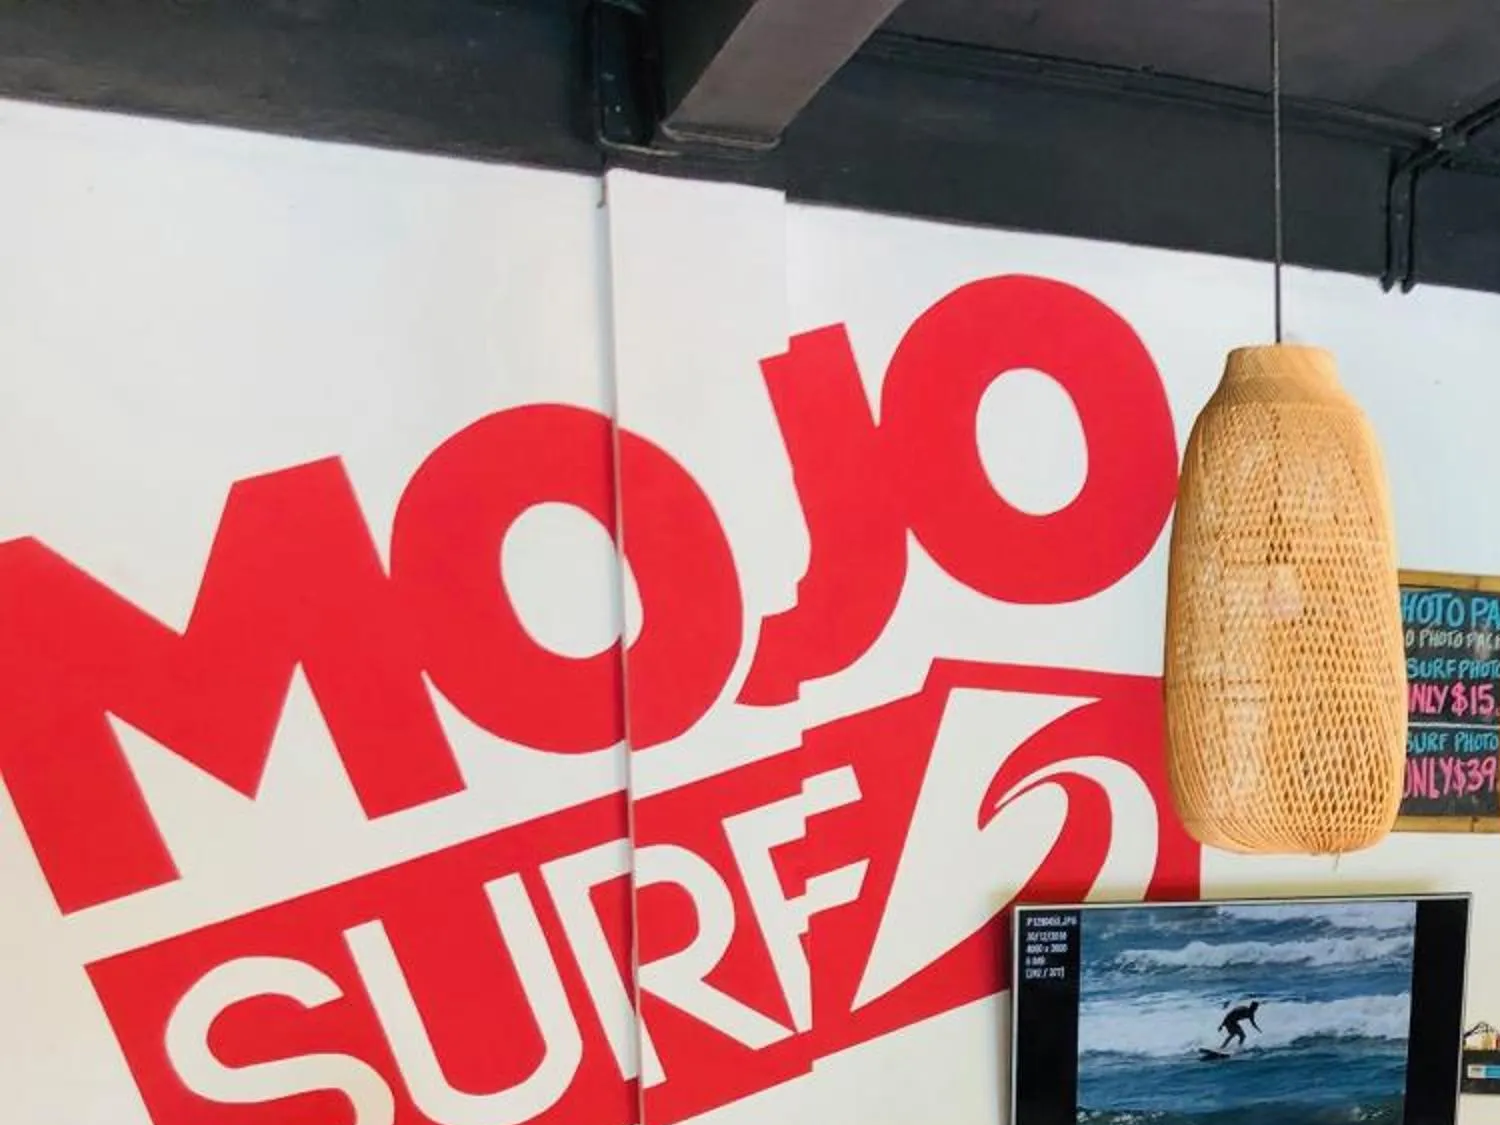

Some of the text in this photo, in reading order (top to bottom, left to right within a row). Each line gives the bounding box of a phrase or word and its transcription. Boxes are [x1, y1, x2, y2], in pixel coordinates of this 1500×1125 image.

[0, 274, 1178, 917] MOJO
[1402, 592, 1465, 628] HOTO
[1419, 629, 1464, 649] PHOTO
[1407, 658, 1457, 679] SURF
[1408, 683, 1449, 714] NLY
[1406, 731, 1449, 754] SURF
